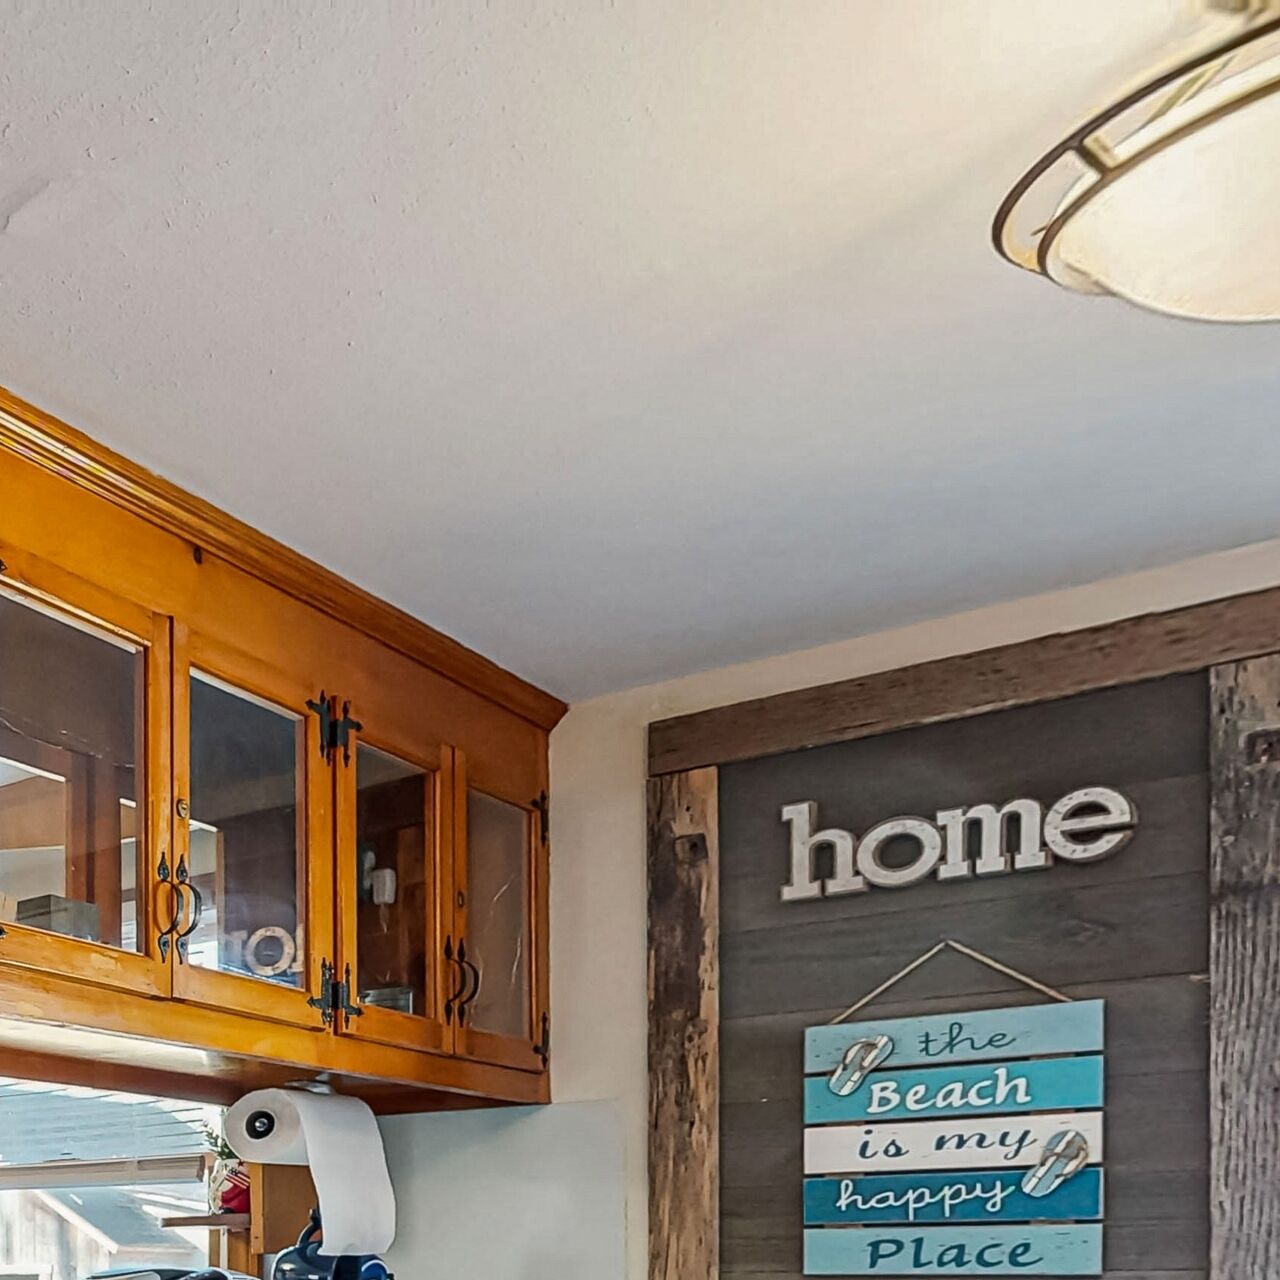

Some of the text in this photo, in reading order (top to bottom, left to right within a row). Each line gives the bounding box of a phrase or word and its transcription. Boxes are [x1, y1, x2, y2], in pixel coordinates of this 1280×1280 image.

[780, 786, 1137, 901] home
[918, 1021, 1017, 1057] the
[865, 1066, 1032, 1115] Beach
[856, 1124, 1038, 1159] is my
[835, 1178, 1017, 1221] happy
[867, 1237, 1044, 1270] Place
